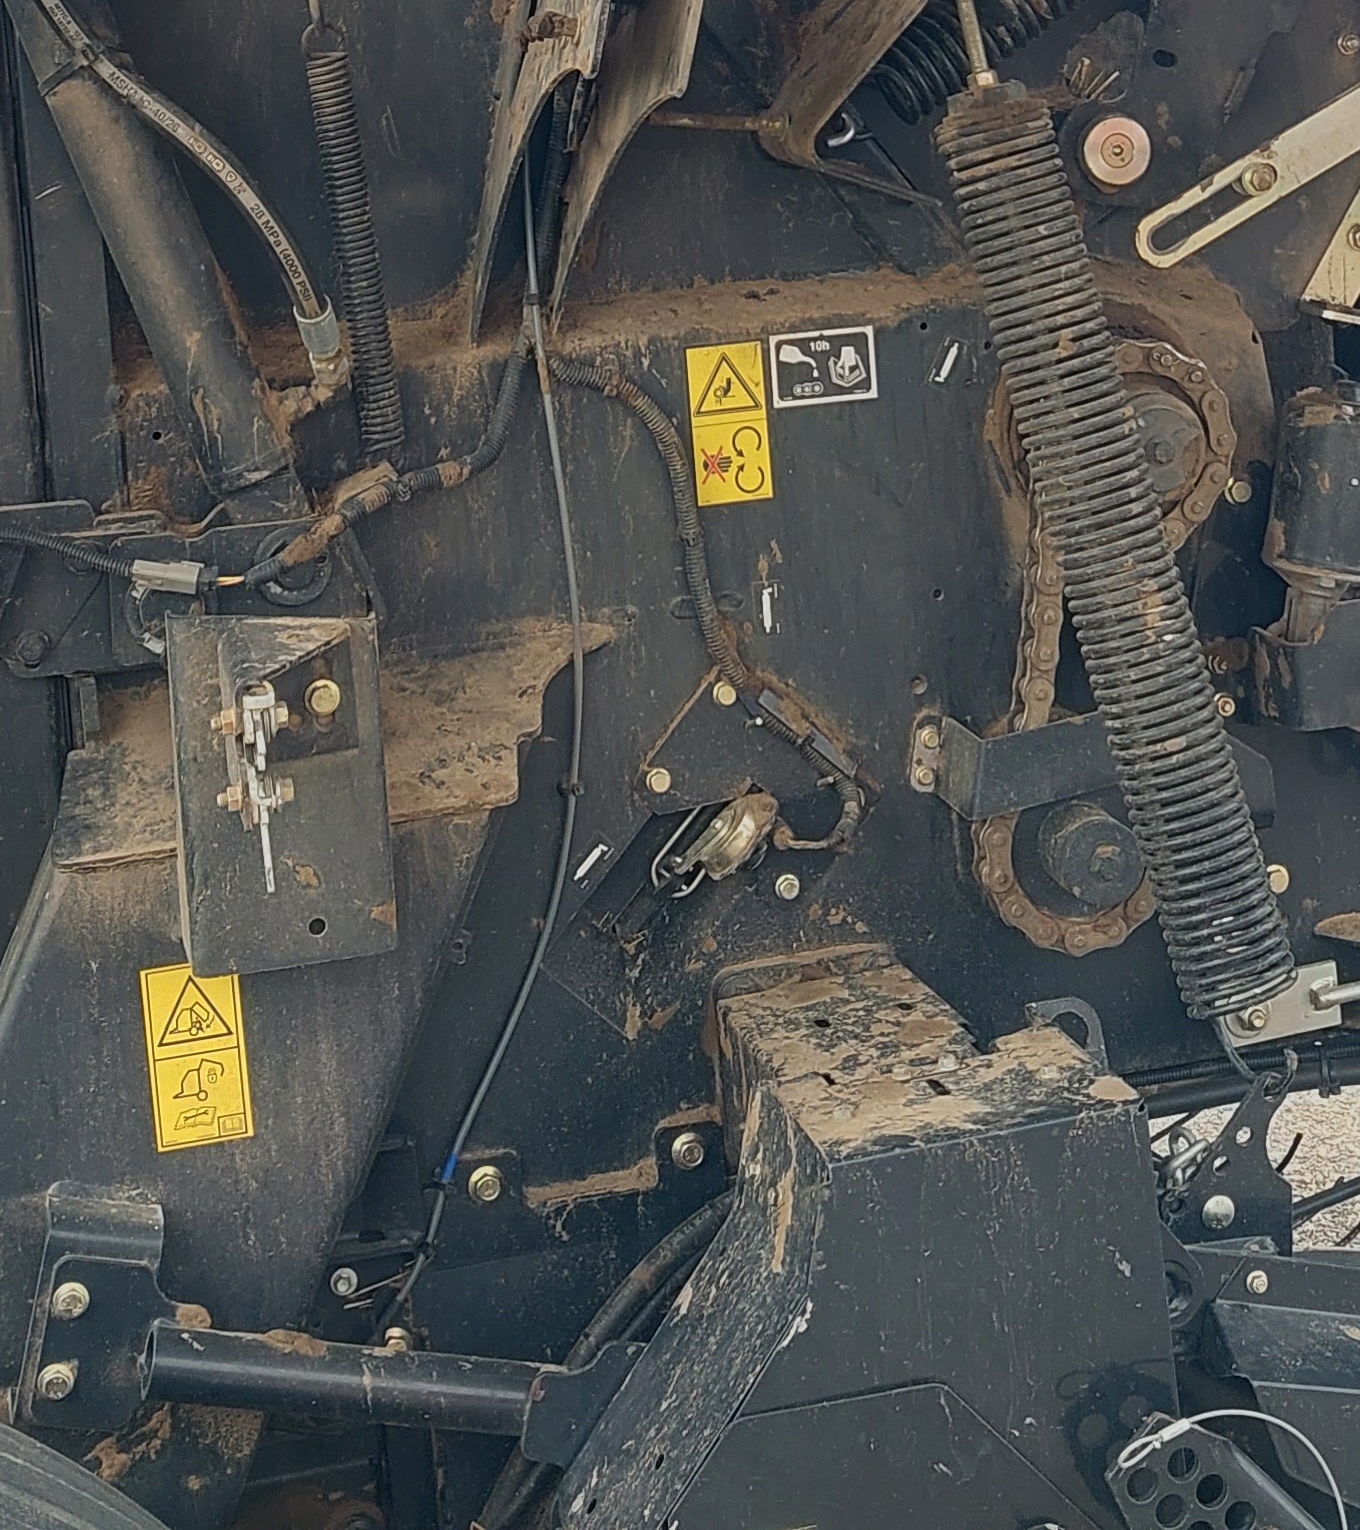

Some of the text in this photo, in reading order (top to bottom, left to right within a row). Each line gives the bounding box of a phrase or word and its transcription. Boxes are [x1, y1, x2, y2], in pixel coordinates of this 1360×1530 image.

[250, 203, 312, 302] 28 MPa (4000 PSI)
[809, 340, 830, 352] 10h
